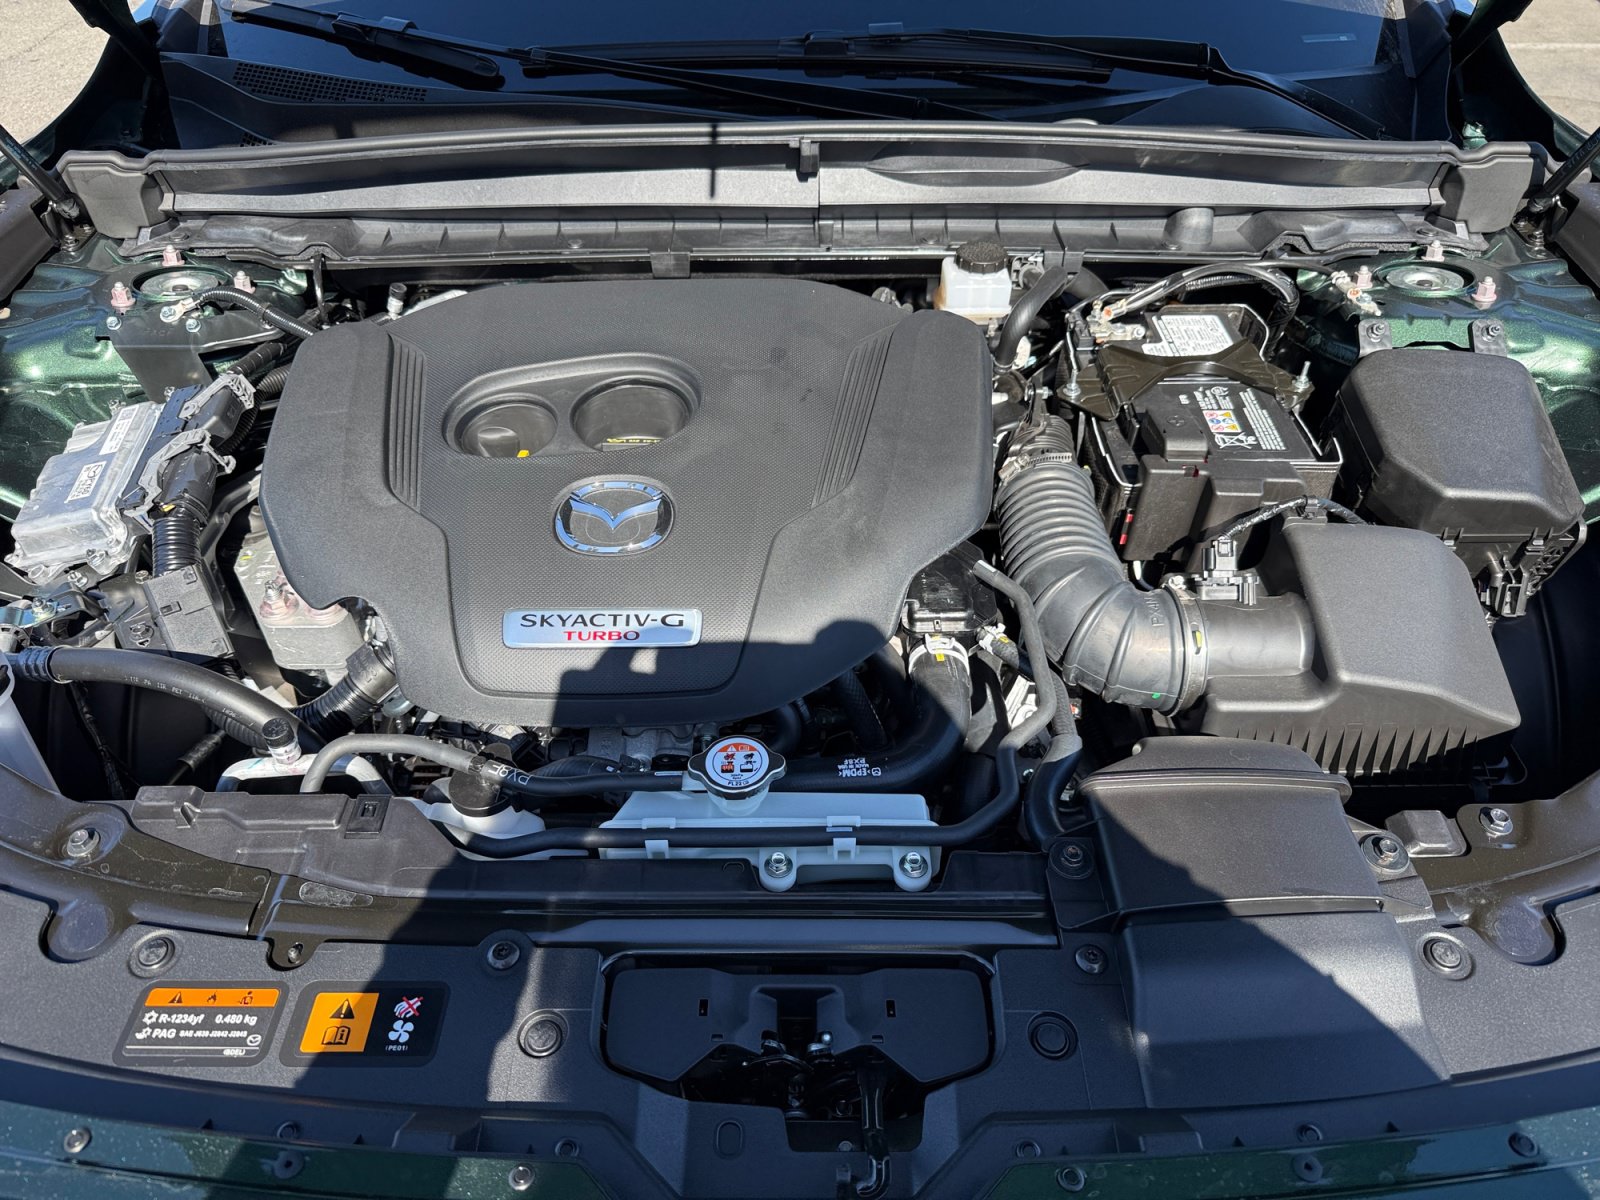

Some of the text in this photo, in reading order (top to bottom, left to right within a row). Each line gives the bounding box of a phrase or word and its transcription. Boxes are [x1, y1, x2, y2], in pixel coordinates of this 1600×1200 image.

[520, 613, 684, 628] SKYACTIV-G
[563, 630, 640, 641] TURBO
[158, 1013, 258, 1026] R-1234yf 0.480 kg
[152, 1028, 177, 1039] PAG
